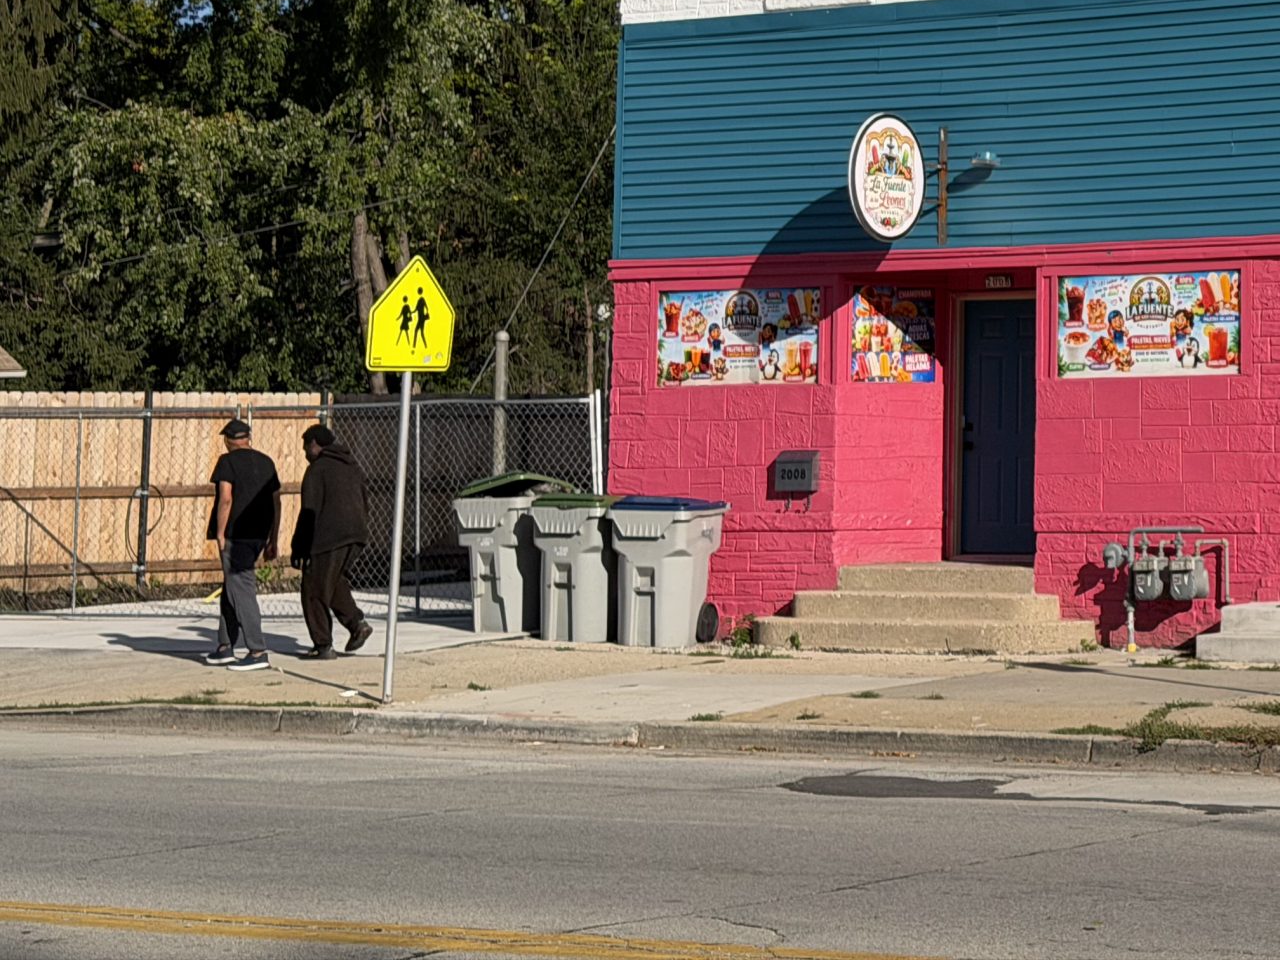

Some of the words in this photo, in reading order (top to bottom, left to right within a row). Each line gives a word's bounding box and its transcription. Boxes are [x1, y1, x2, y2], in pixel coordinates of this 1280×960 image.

[869, 176, 881, 194] La
[881, 176, 906, 193] Fuente
[1138, 303, 1174, 319] FUENTE
[780, 468, 806, 480] 2008
